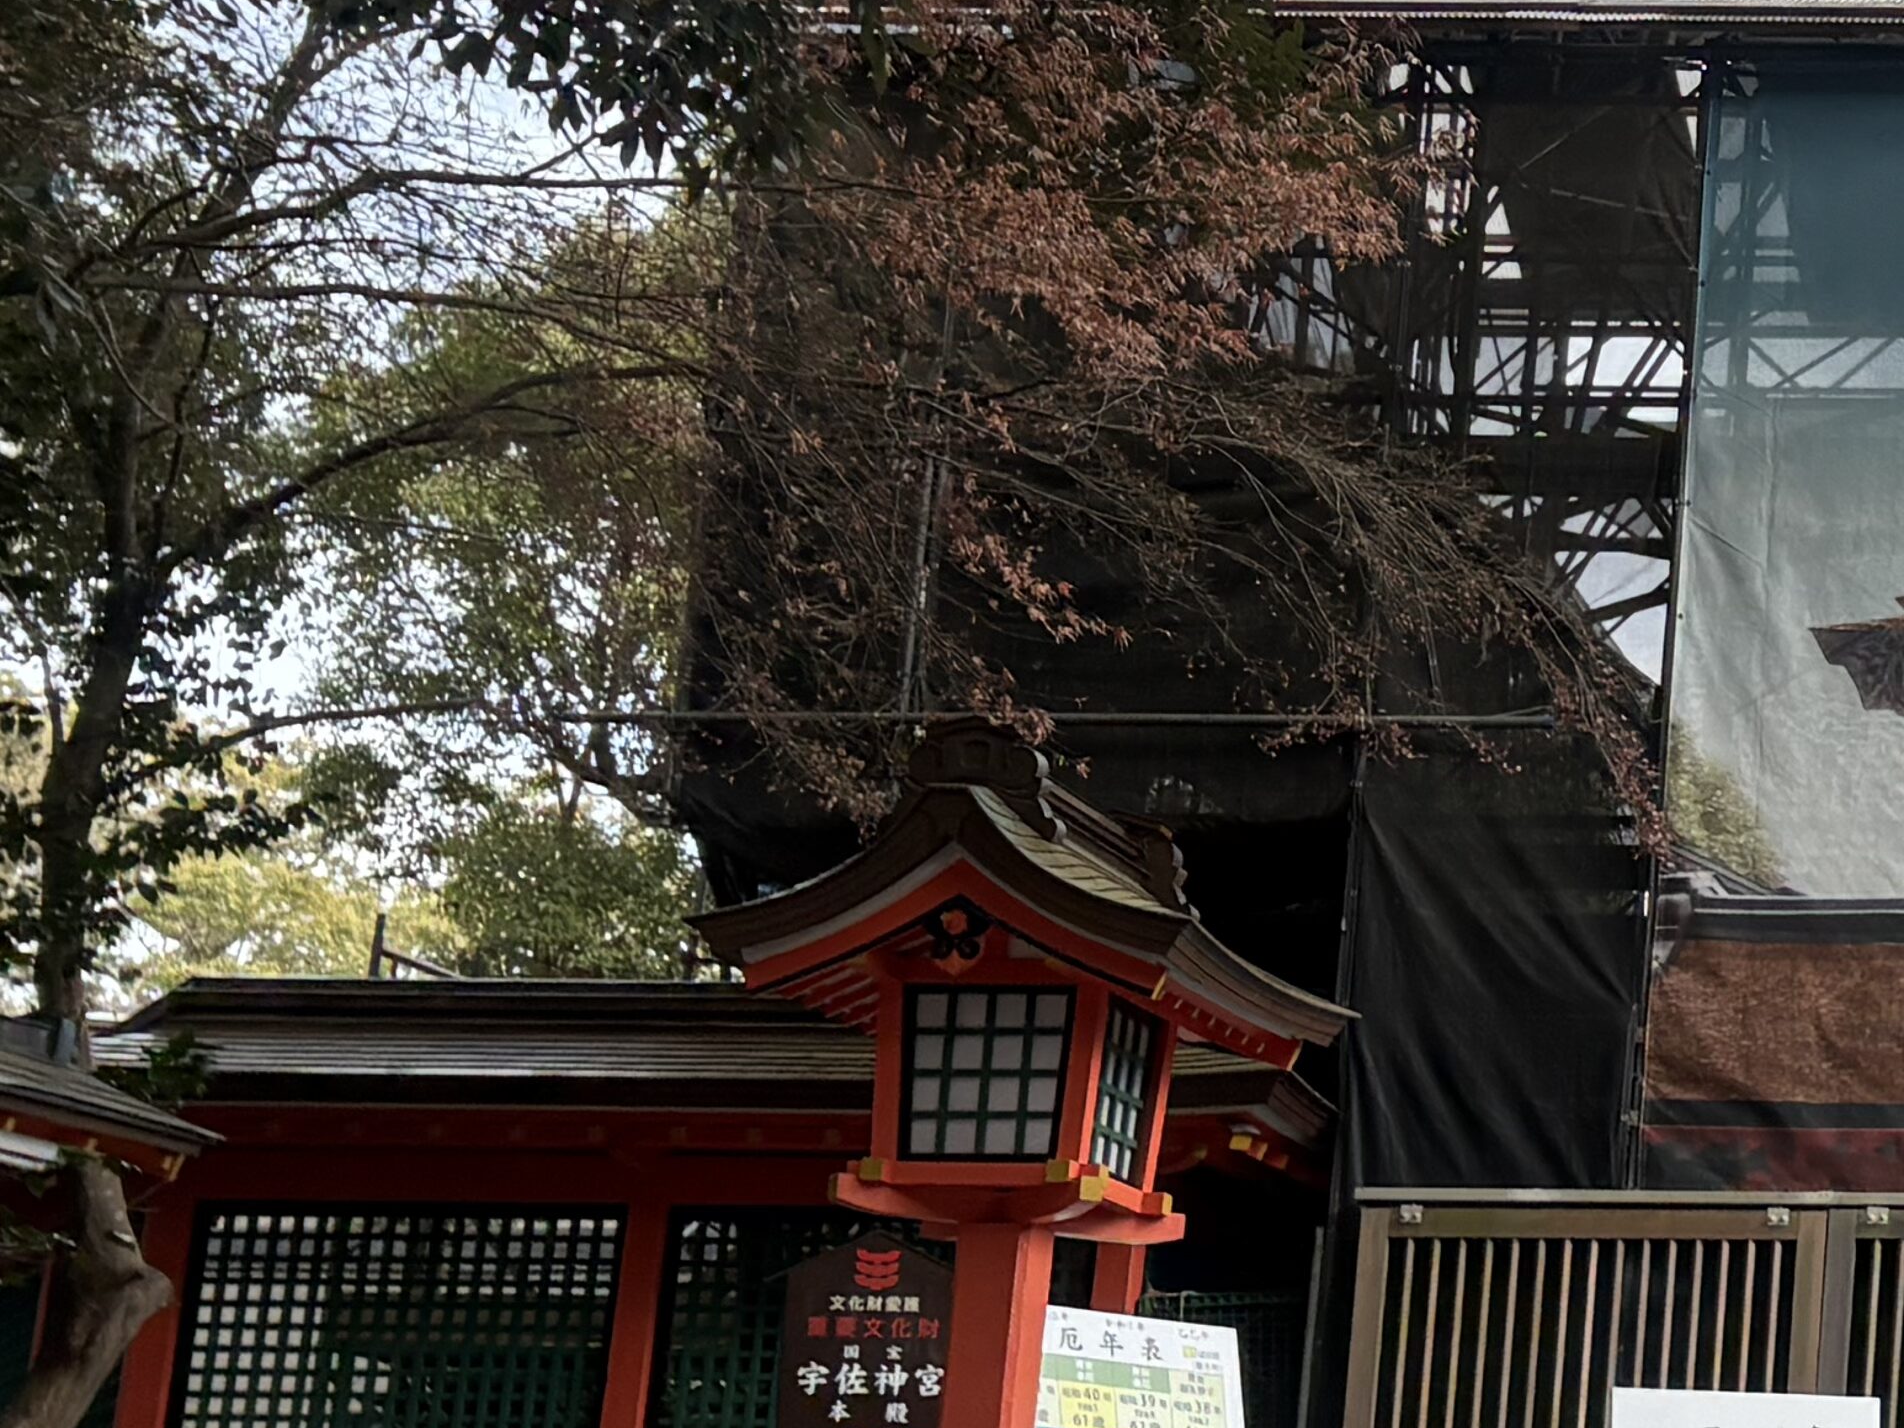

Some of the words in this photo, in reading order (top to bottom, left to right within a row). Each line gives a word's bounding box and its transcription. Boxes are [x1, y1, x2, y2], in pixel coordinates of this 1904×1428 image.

[1059, 1327, 1165, 1362] 厄年表
[797, 1361, 944, 1397] 宇佐神宮
